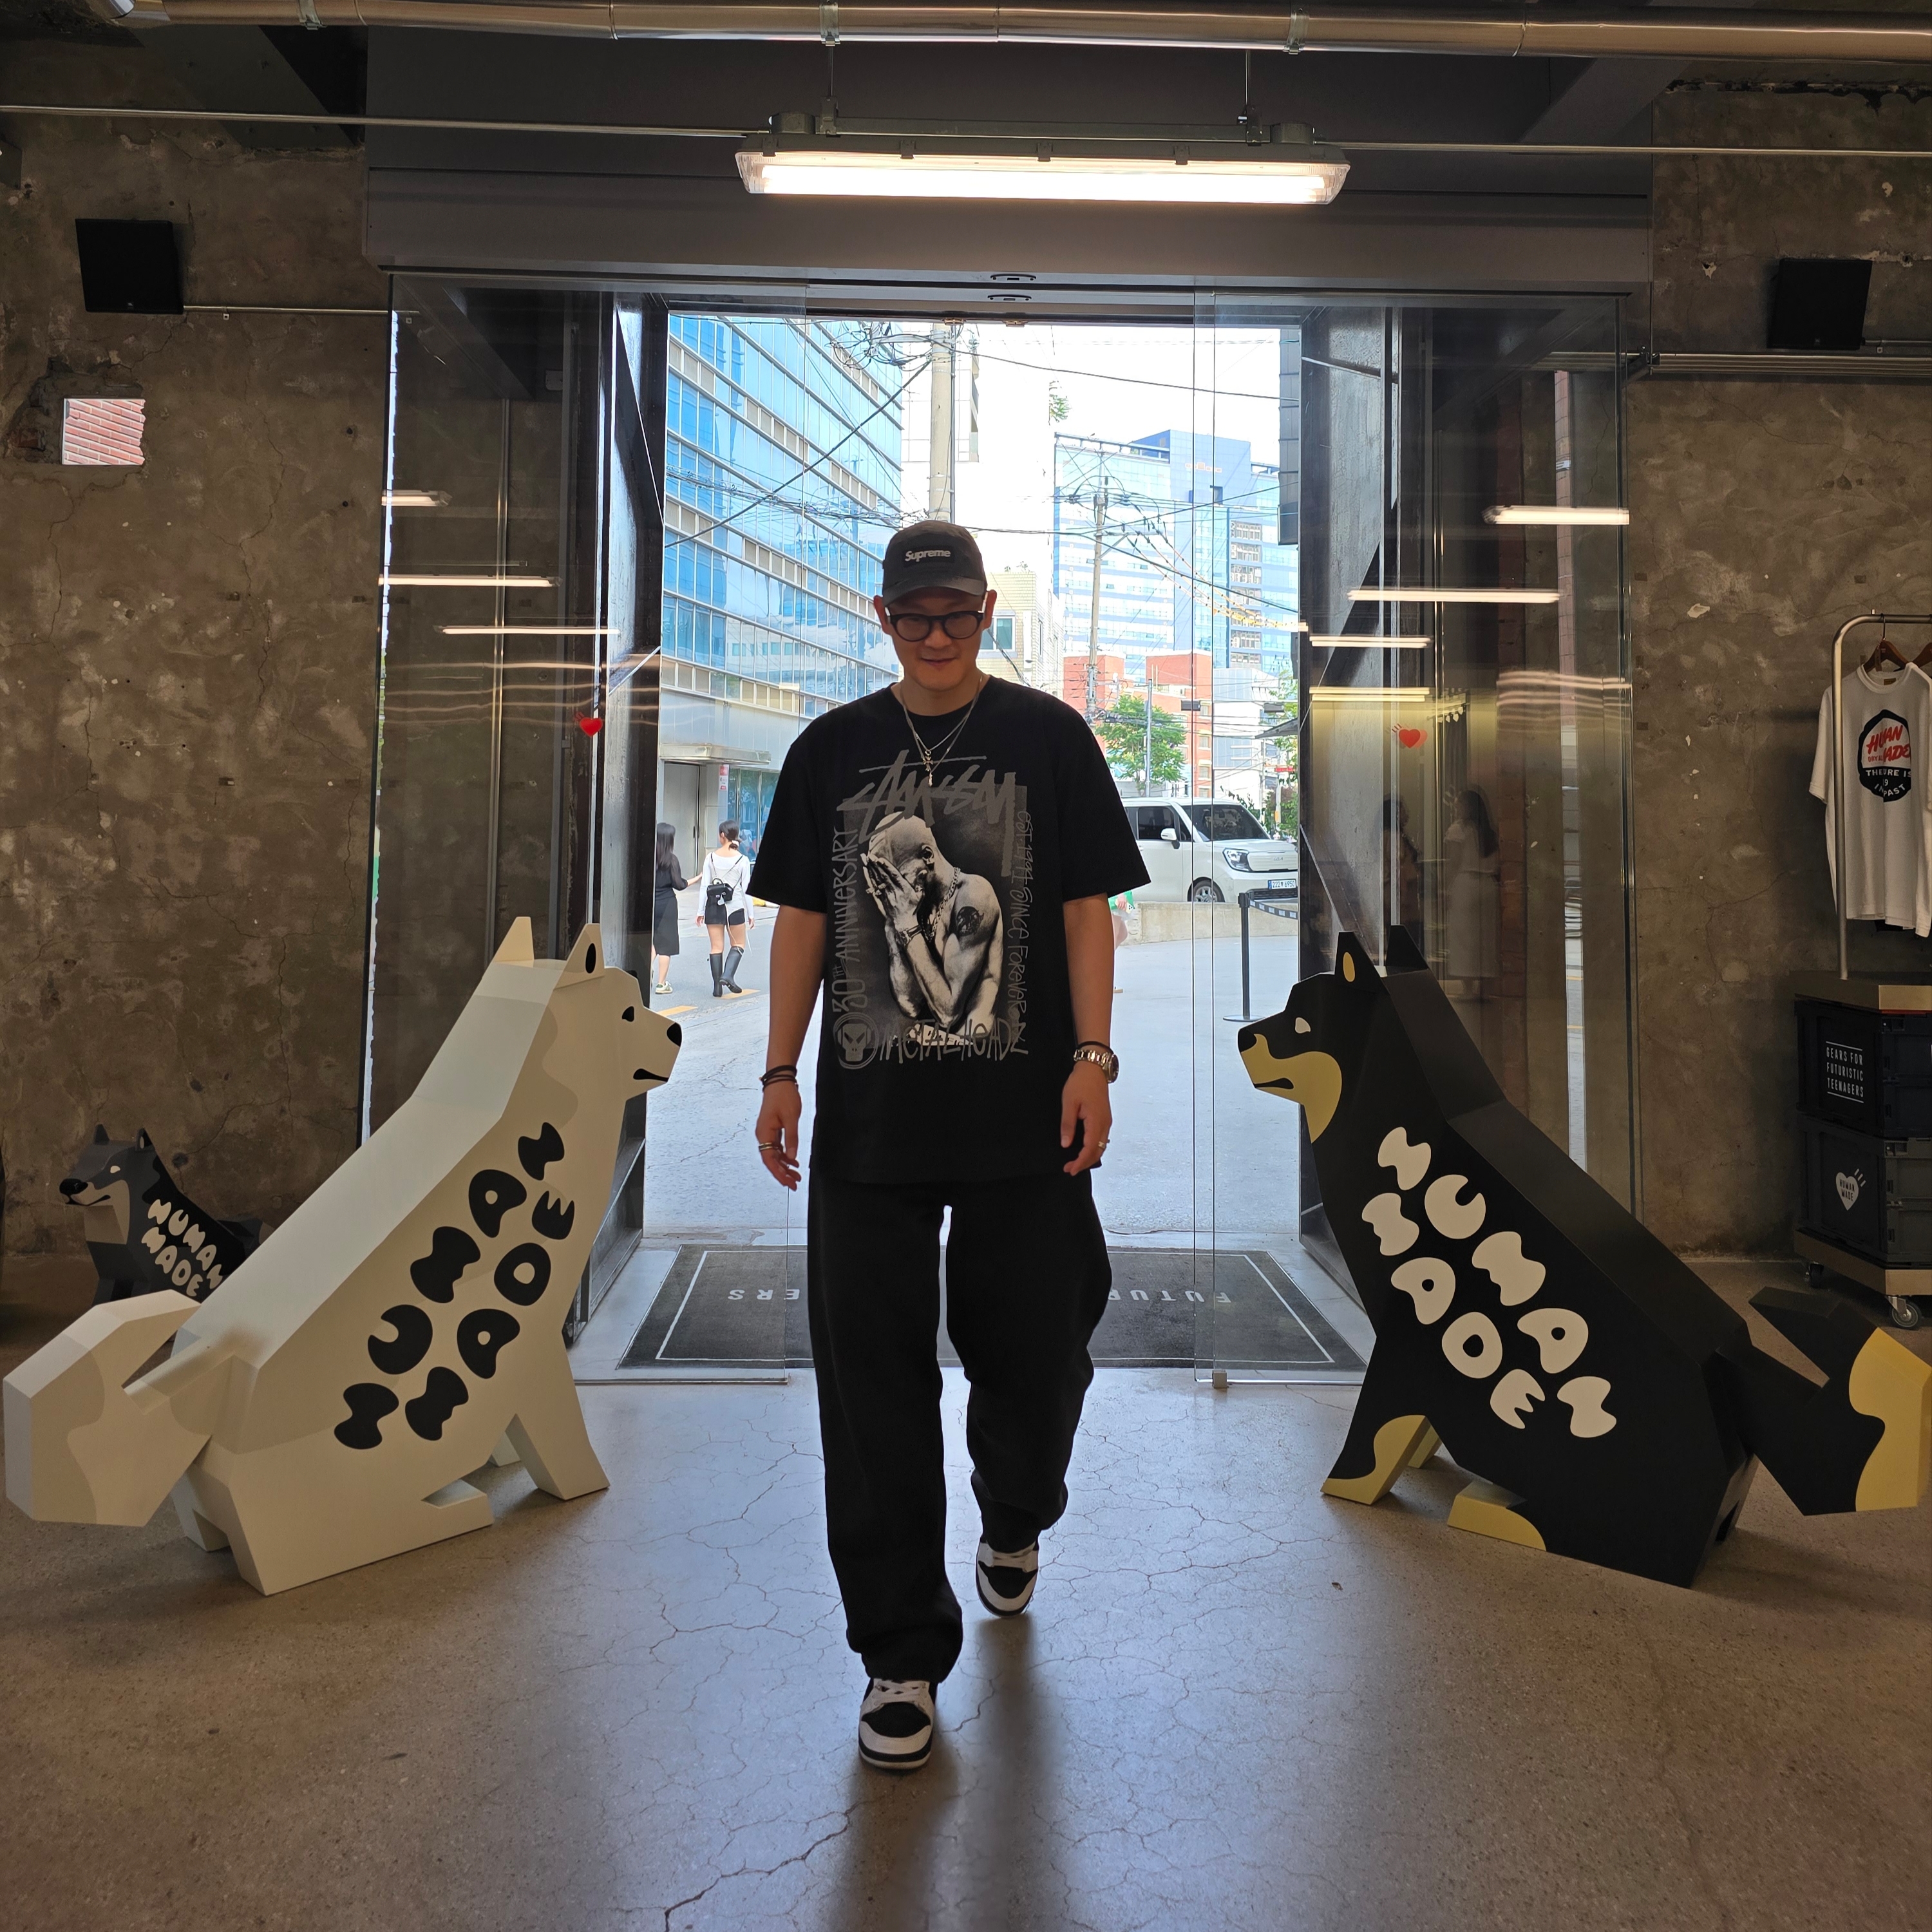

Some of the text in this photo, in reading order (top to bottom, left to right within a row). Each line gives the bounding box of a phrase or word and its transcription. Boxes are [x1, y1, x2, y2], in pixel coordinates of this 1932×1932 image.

[905, 550, 951, 562] Supreme
[1883, 783, 1906, 797] PAST
[1826, 1047, 1863, 1066] GEARS FOR
[1826, 1062, 1863, 1081] FUTURISTIC
[1827, 1077, 1864, 1097] TEENAGERS
[1840, 1179, 1855, 1192] HUMAN
[1842, 1189, 1853, 1202] MADE
